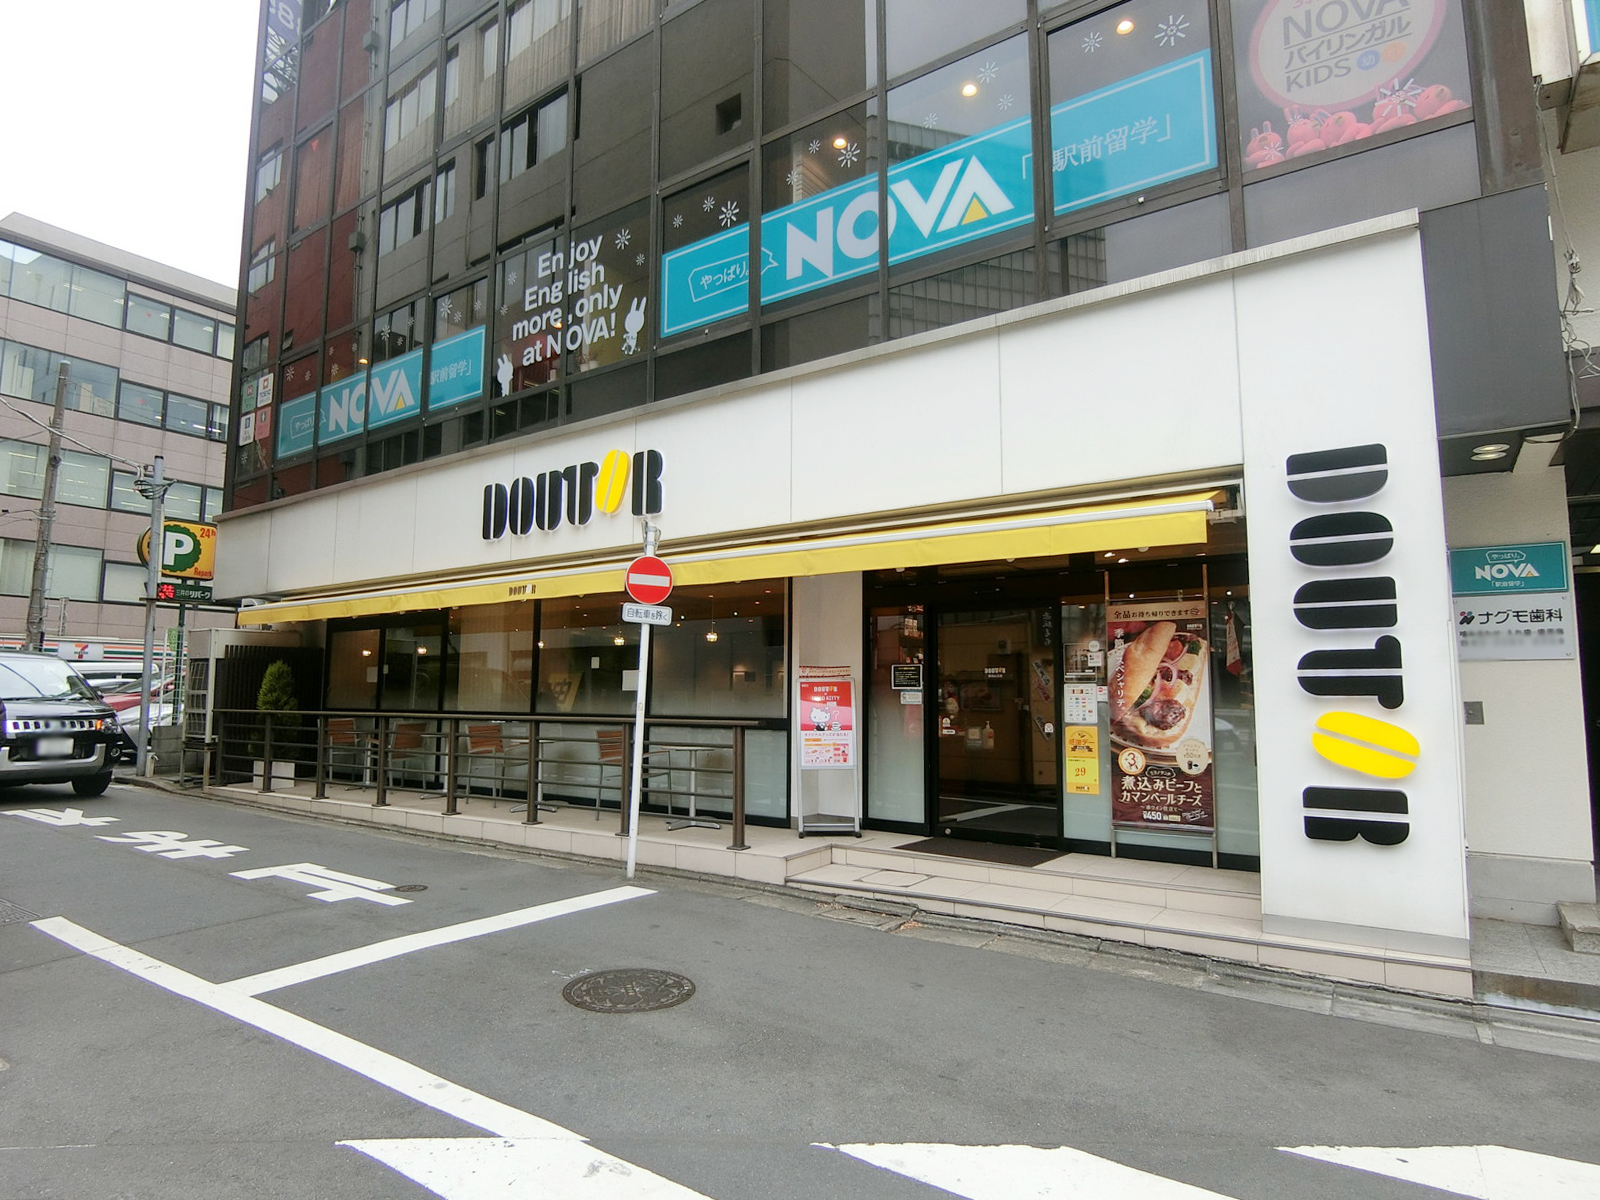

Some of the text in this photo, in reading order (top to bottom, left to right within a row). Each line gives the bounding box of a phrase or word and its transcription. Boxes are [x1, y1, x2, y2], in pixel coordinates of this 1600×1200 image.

[1284, 16, 1411, 69] バイリンガル
[1286, 58, 1351, 93] KIDS
[786, 154, 1015, 279] NOVA
[538, 235, 603, 278] Enjoy
[525, 261, 605, 311] English
[575, 284, 623, 318] only
[522, 312, 616, 367] at NOVA!
[329, 368, 415, 433] NOVA
[482, 449, 663, 540] DOUTOR
[163, 531, 194, 566] P
[1475, 563, 1540, 581] NOVA
[508, 584, 537, 597] DOUTOR
[627, 607, 668, 622] 自転車を除く
[1114, 608, 1191, 619] 全品お持ち帰りできます
[1478, 608, 1563, 625] ナグモ歯科
[1286, 442, 1420, 846] DOUTOR
[1075, 767, 1087, 777] 29
[1121, 775, 1203, 794] 煮込みビーフと
[1119, 790, 1203, 807] カマンベールチーズ
